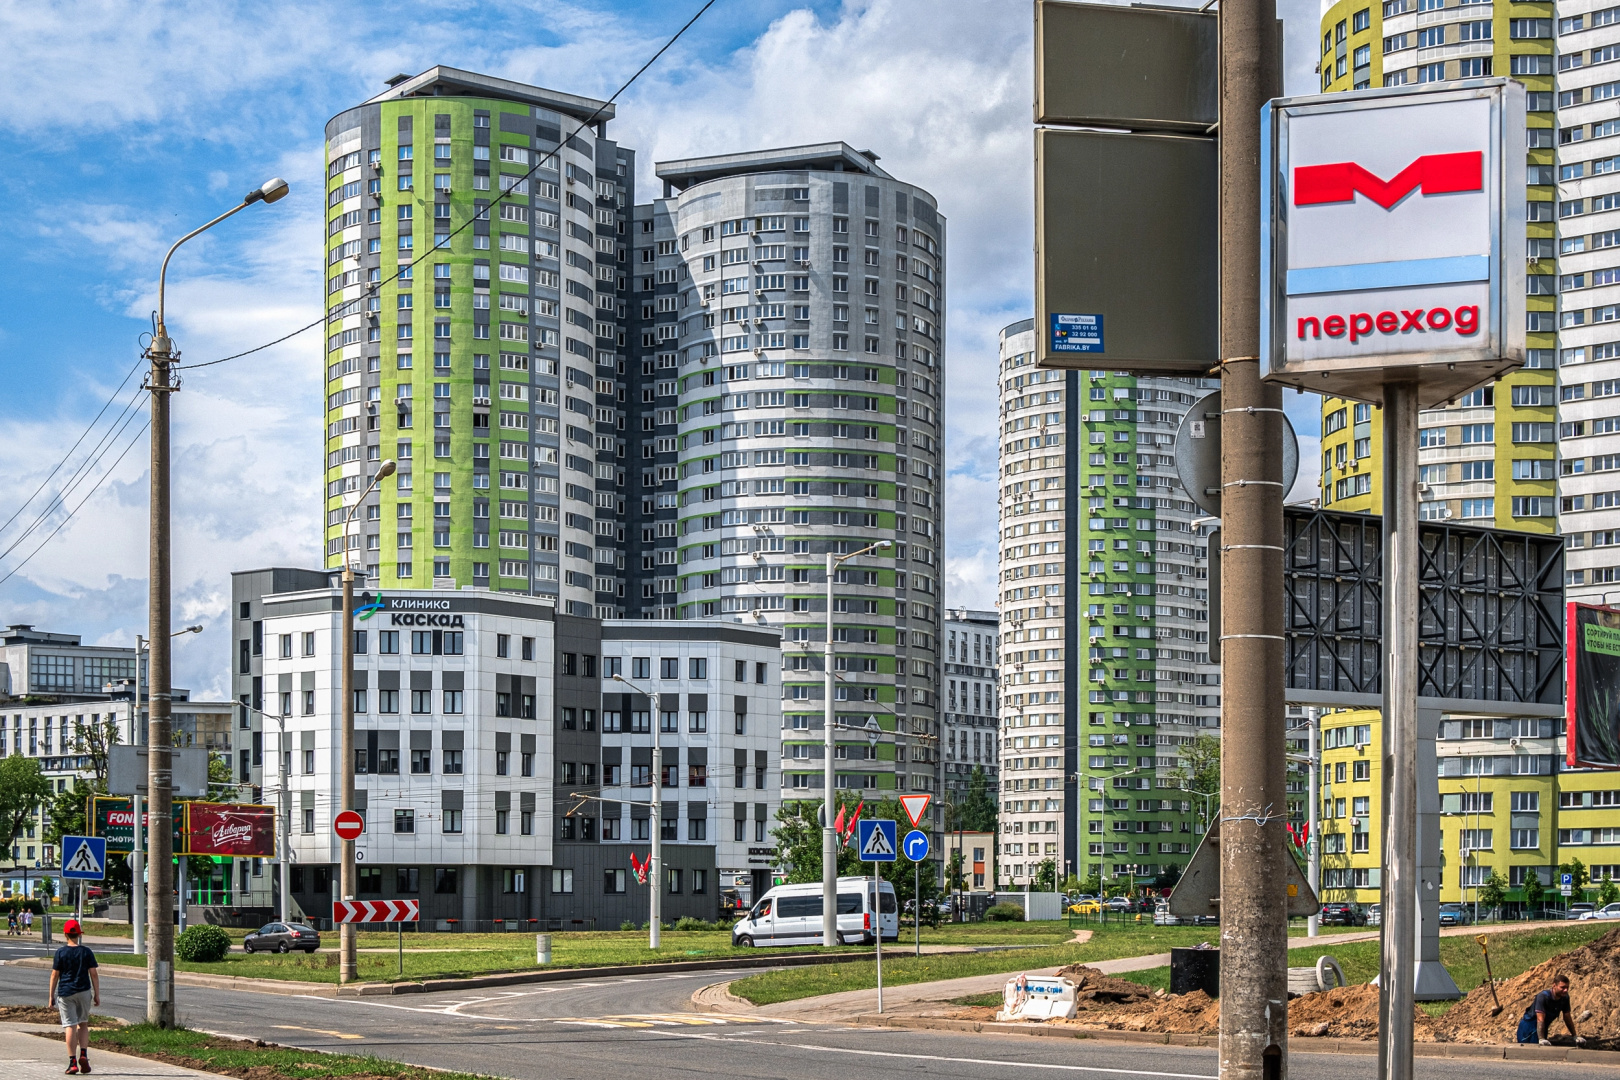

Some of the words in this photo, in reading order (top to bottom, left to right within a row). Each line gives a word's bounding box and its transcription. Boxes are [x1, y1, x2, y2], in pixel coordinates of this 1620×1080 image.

[392, 600, 450, 609] клиника
[392, 613, 464, 628] каскад
[1586, 628, 1612, 639] СОРТИРУЙ
[1587, 640, 1604, 649] ЧТОБЫ
